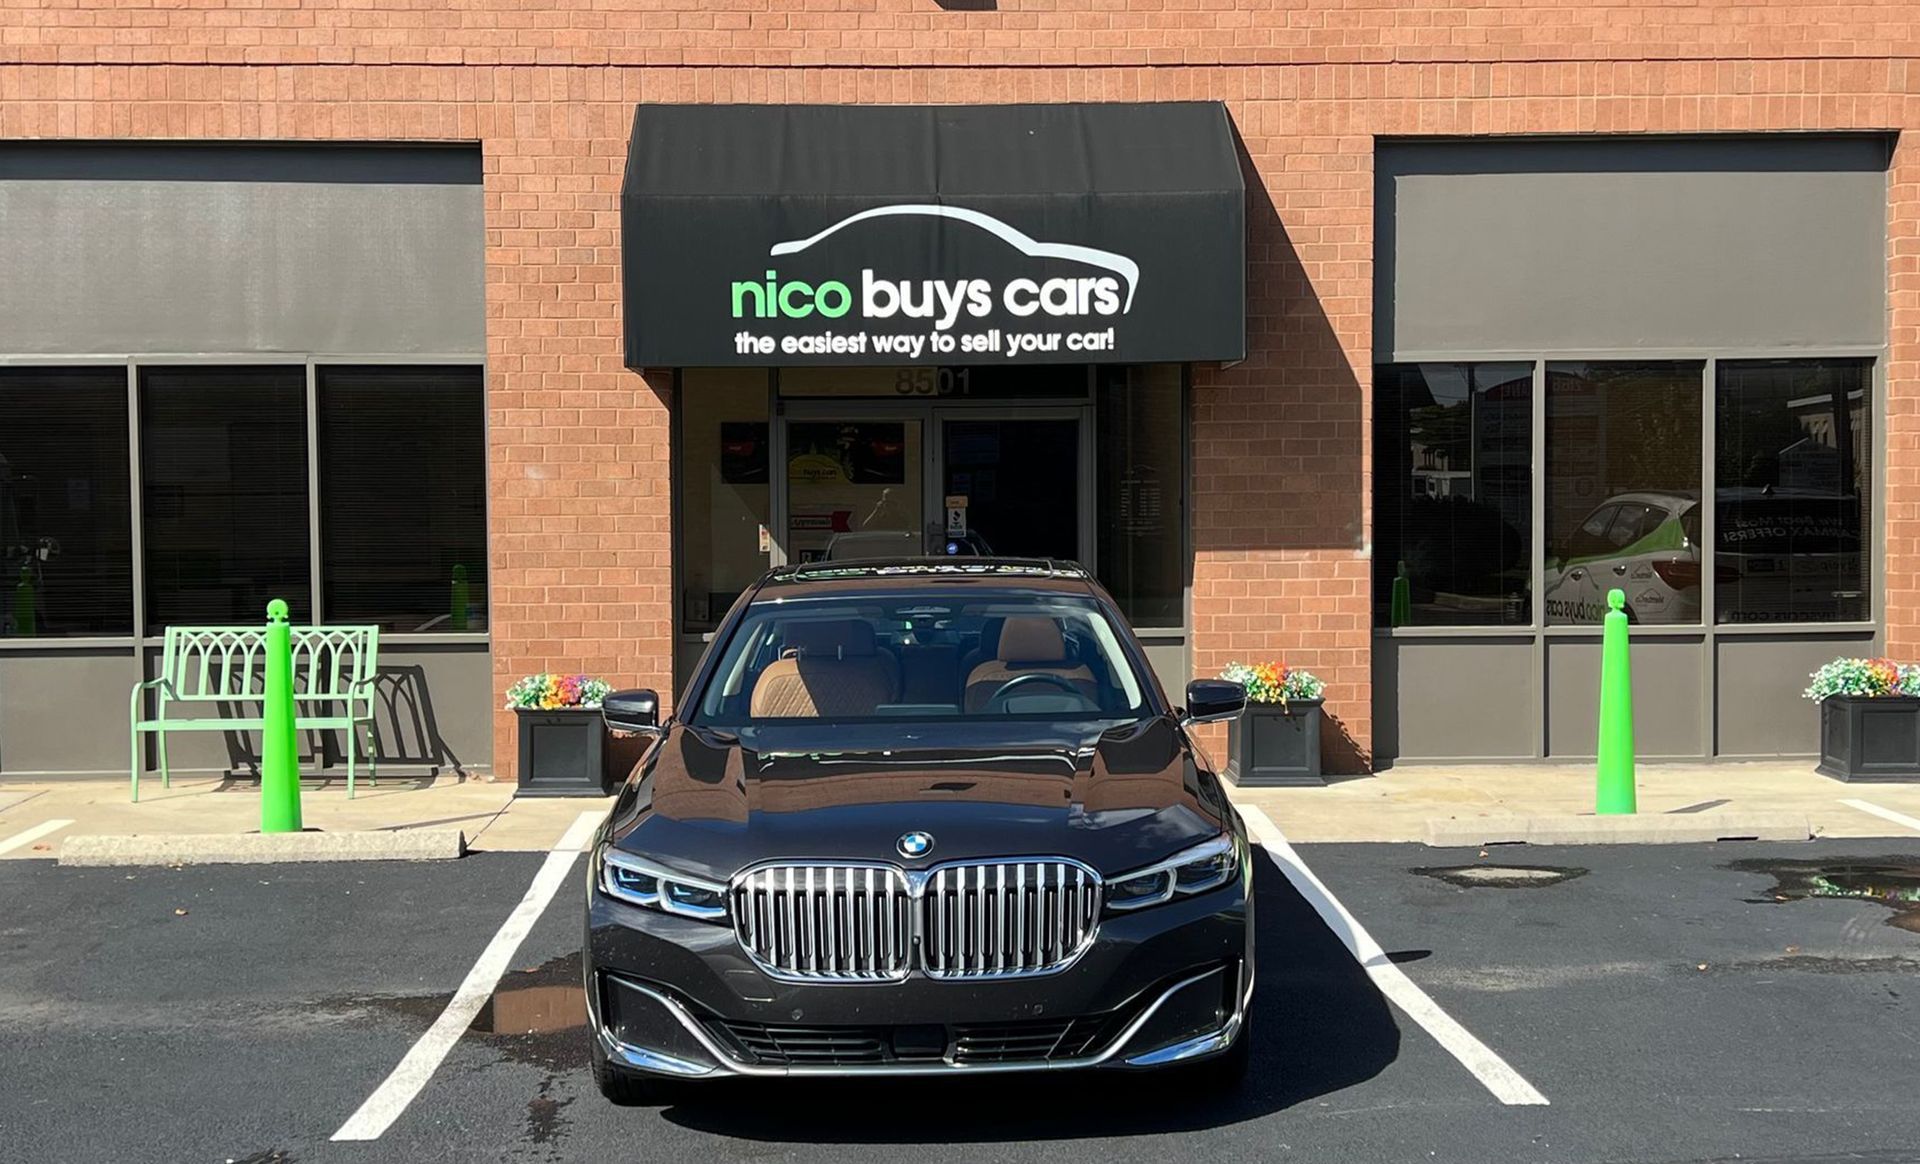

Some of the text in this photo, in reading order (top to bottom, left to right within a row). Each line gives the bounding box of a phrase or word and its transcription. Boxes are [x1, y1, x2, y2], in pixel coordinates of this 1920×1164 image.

[731, 268, 1119, 330] nico buys cars
[734, 327, 1115, 358] the easiest way to sell your car!
[895, 367, 971, 394] 8501
